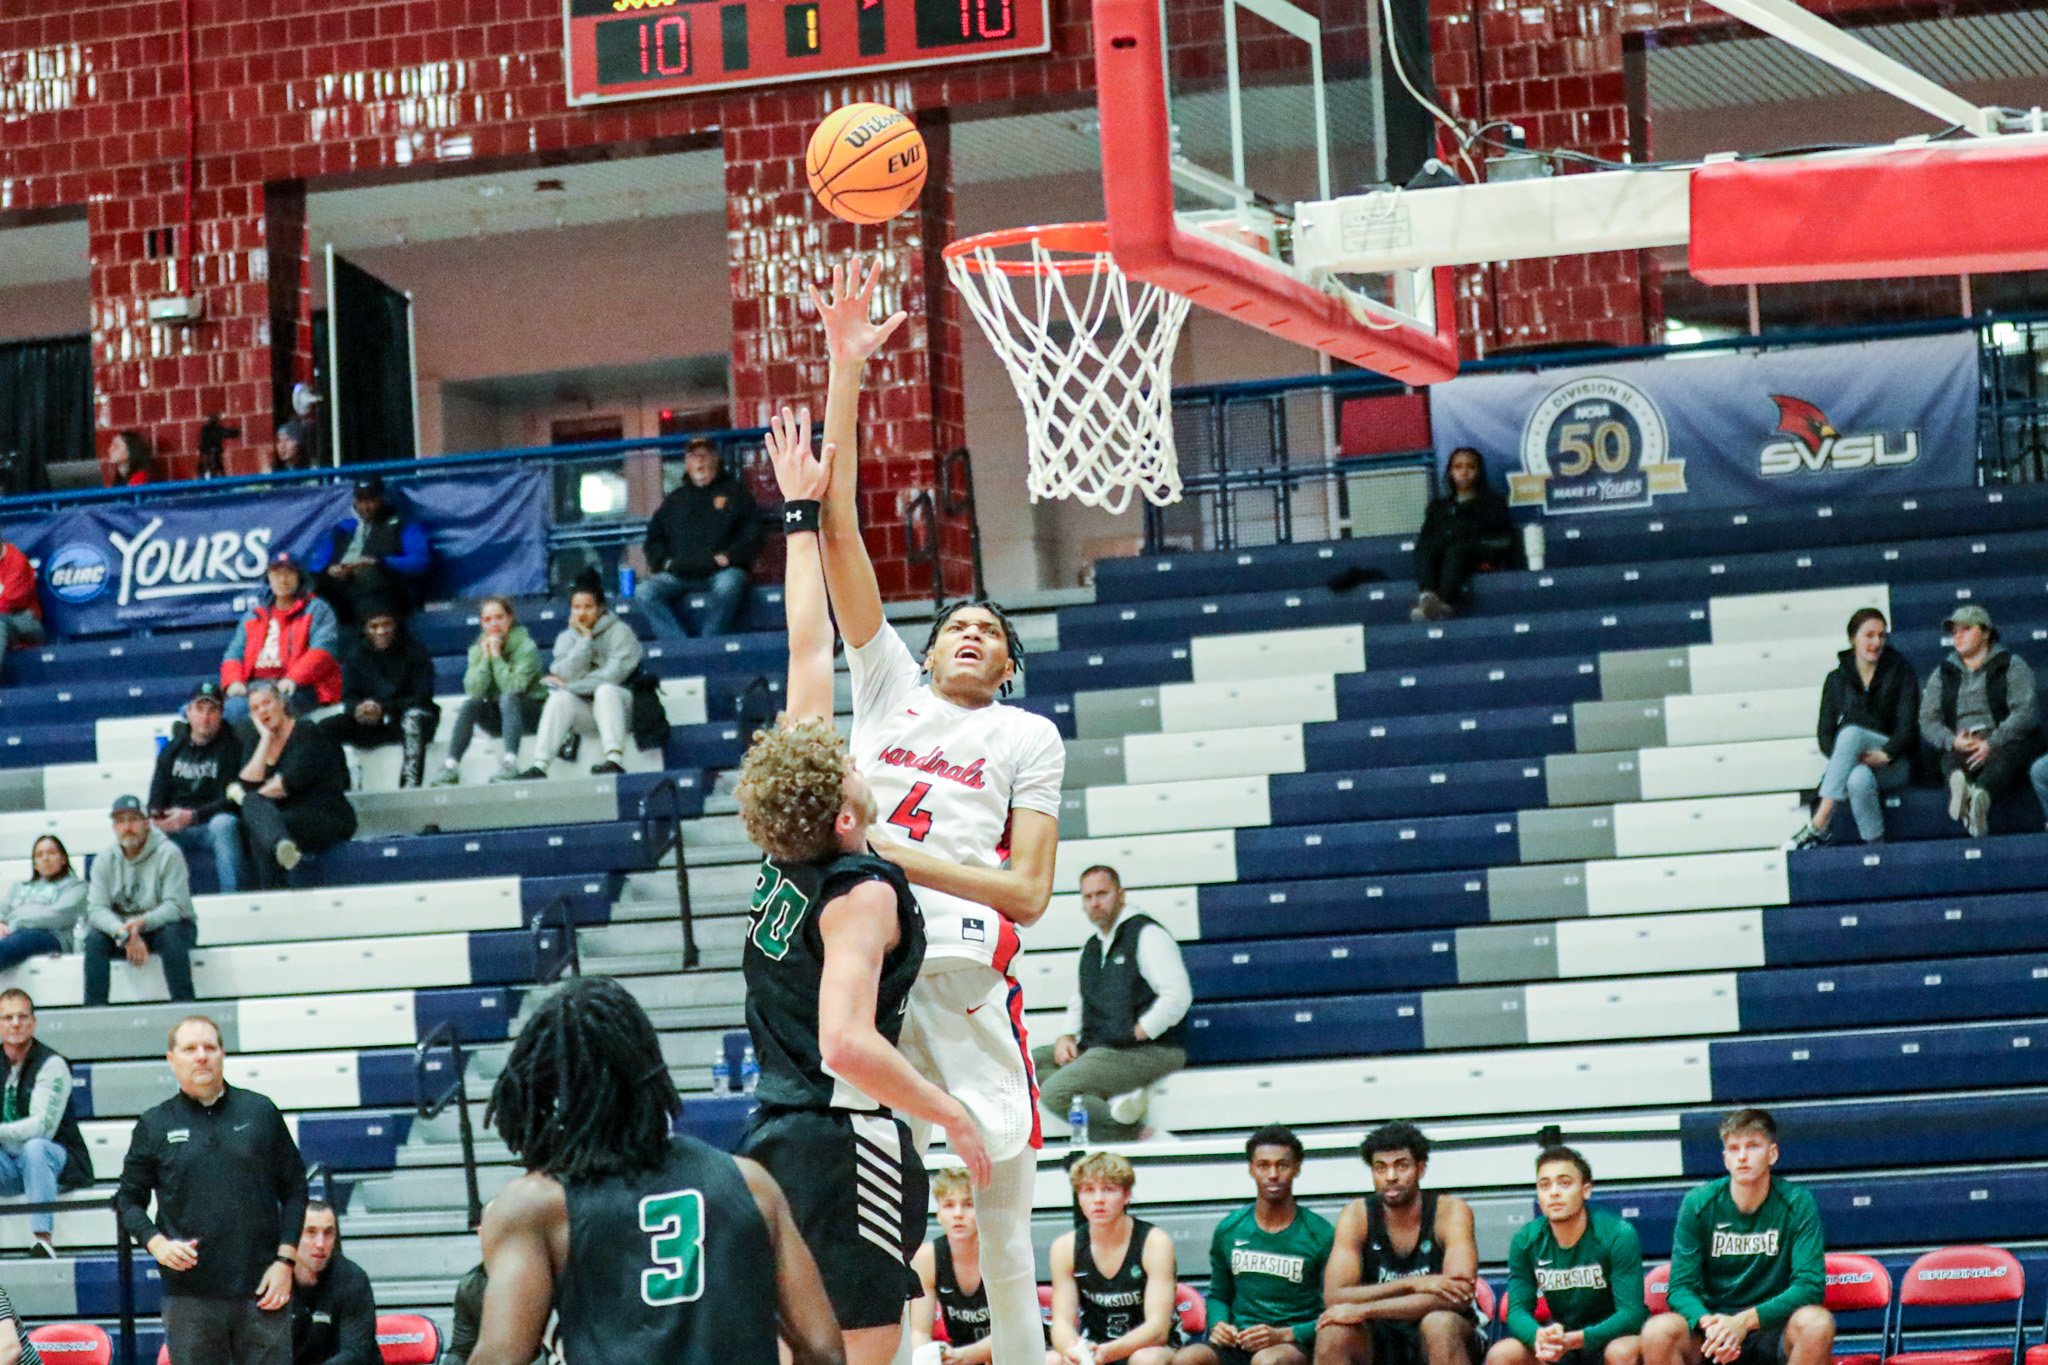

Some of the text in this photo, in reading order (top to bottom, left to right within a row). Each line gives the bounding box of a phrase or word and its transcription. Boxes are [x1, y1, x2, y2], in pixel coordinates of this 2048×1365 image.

[806, 9, 817, 49] 1
[961, 0, 1012, 38] 10
[640, 16, 688, 76] 10
[845, 113, 907, 149] Wilso
[1552, 383, 1618, 409] DIVISION
[1559, 420, 1632, 477] 50
[1760, 431, 1918, 475] SVSU
[1553, 487, 1585, 499] MAKE
[1586, 485, 1598, 497] IT
[1598, 478, 1643, 500] YOURS
[109, 516, 272, 606] YOURS
[886, 780, 933, 843] 4
[638, 1188, 706, 1307] 3
[1231, 1249, 1305, 1284] PARKSIDE
[1535, 1264, 1607, 1291] PARKSIDE
[1919, 1266, 2008, 1281] CARDINALS
[31, 1340, 99, 1352] ARDINALS
